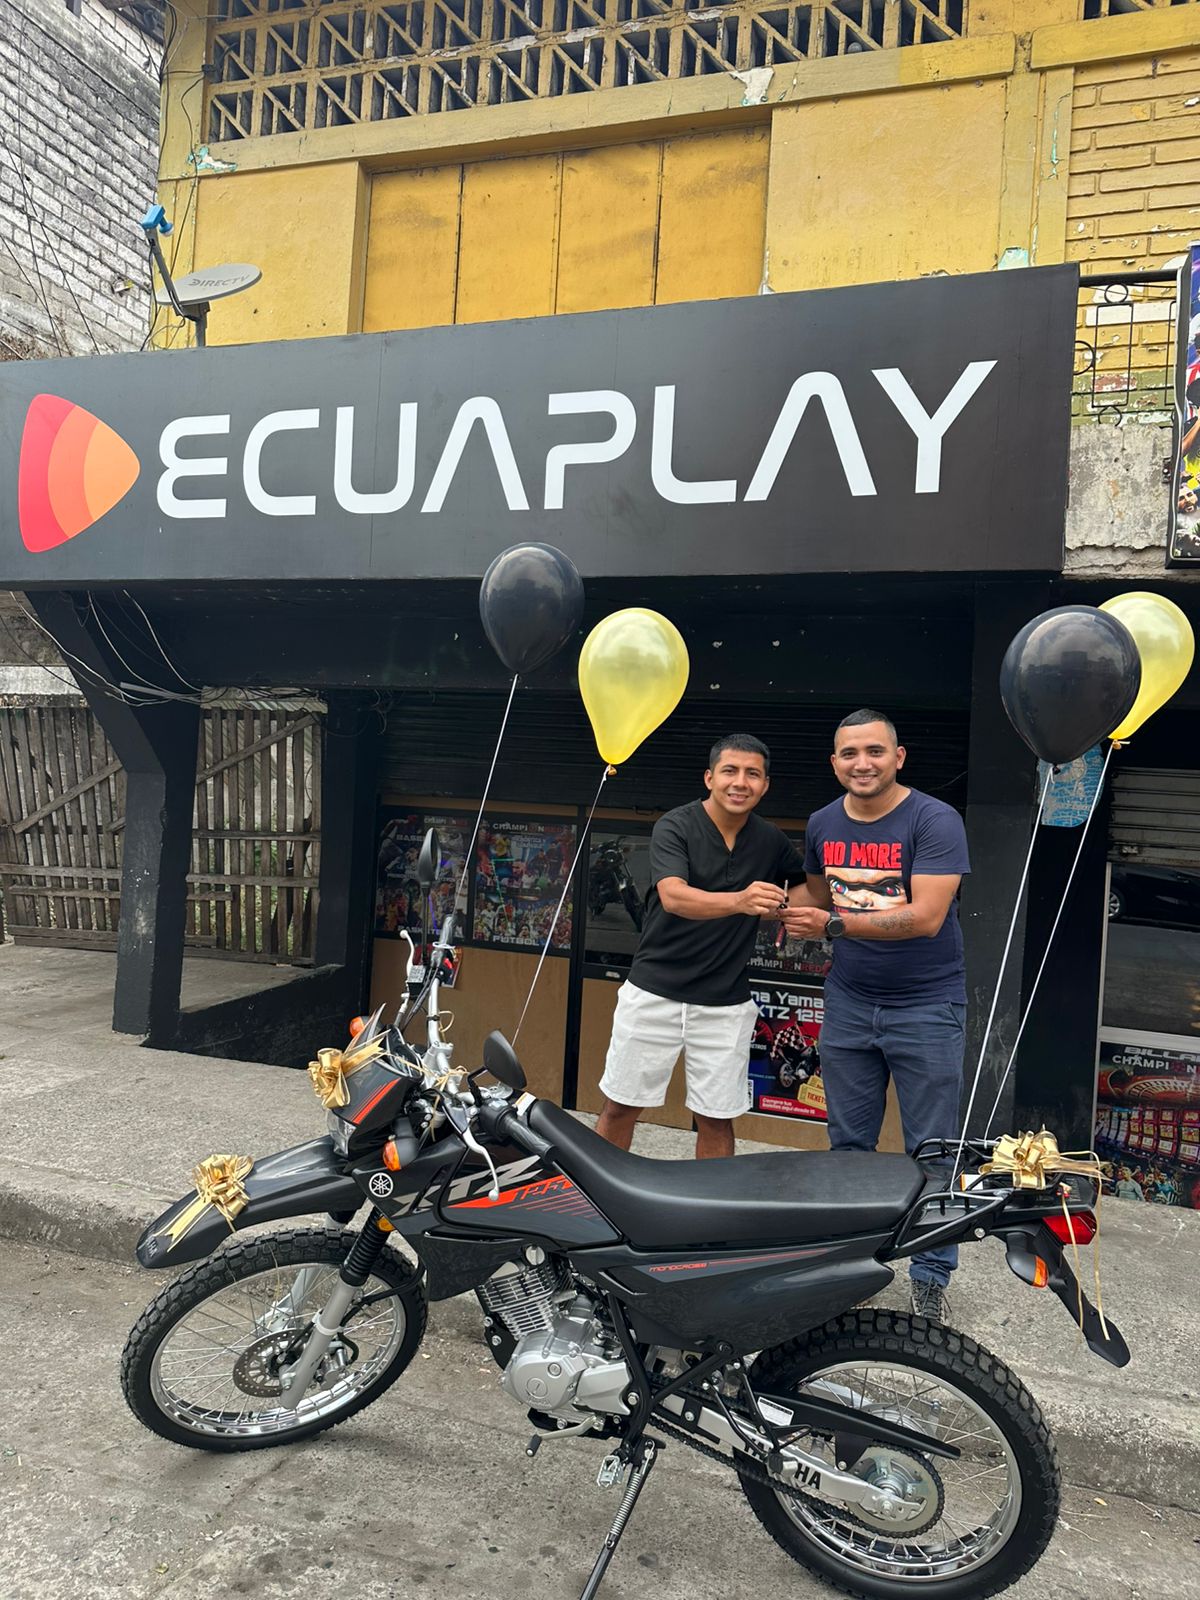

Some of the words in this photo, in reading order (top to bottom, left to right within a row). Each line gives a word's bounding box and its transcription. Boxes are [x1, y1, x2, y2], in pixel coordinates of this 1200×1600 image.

[189, 274, 250, 287] DIRECTV
[156, 360, 998, 519] ECUAPLAY
[823, 841, 846, 866] NO
[849, 842, 902, 869] MORE
[492, 935, 540, 947] FUTBOL
[747, 957, 821, 973] HAMPIONRED
[776, 991, 825, 1009] Yama
[795, 1009, 825, 1024] 125
[1124, 1046, 1200, 1063] BILLA
[1112, 1053, 1200, 1074] CHAMPION
[390, 1154, 544, 1218] XTZ
